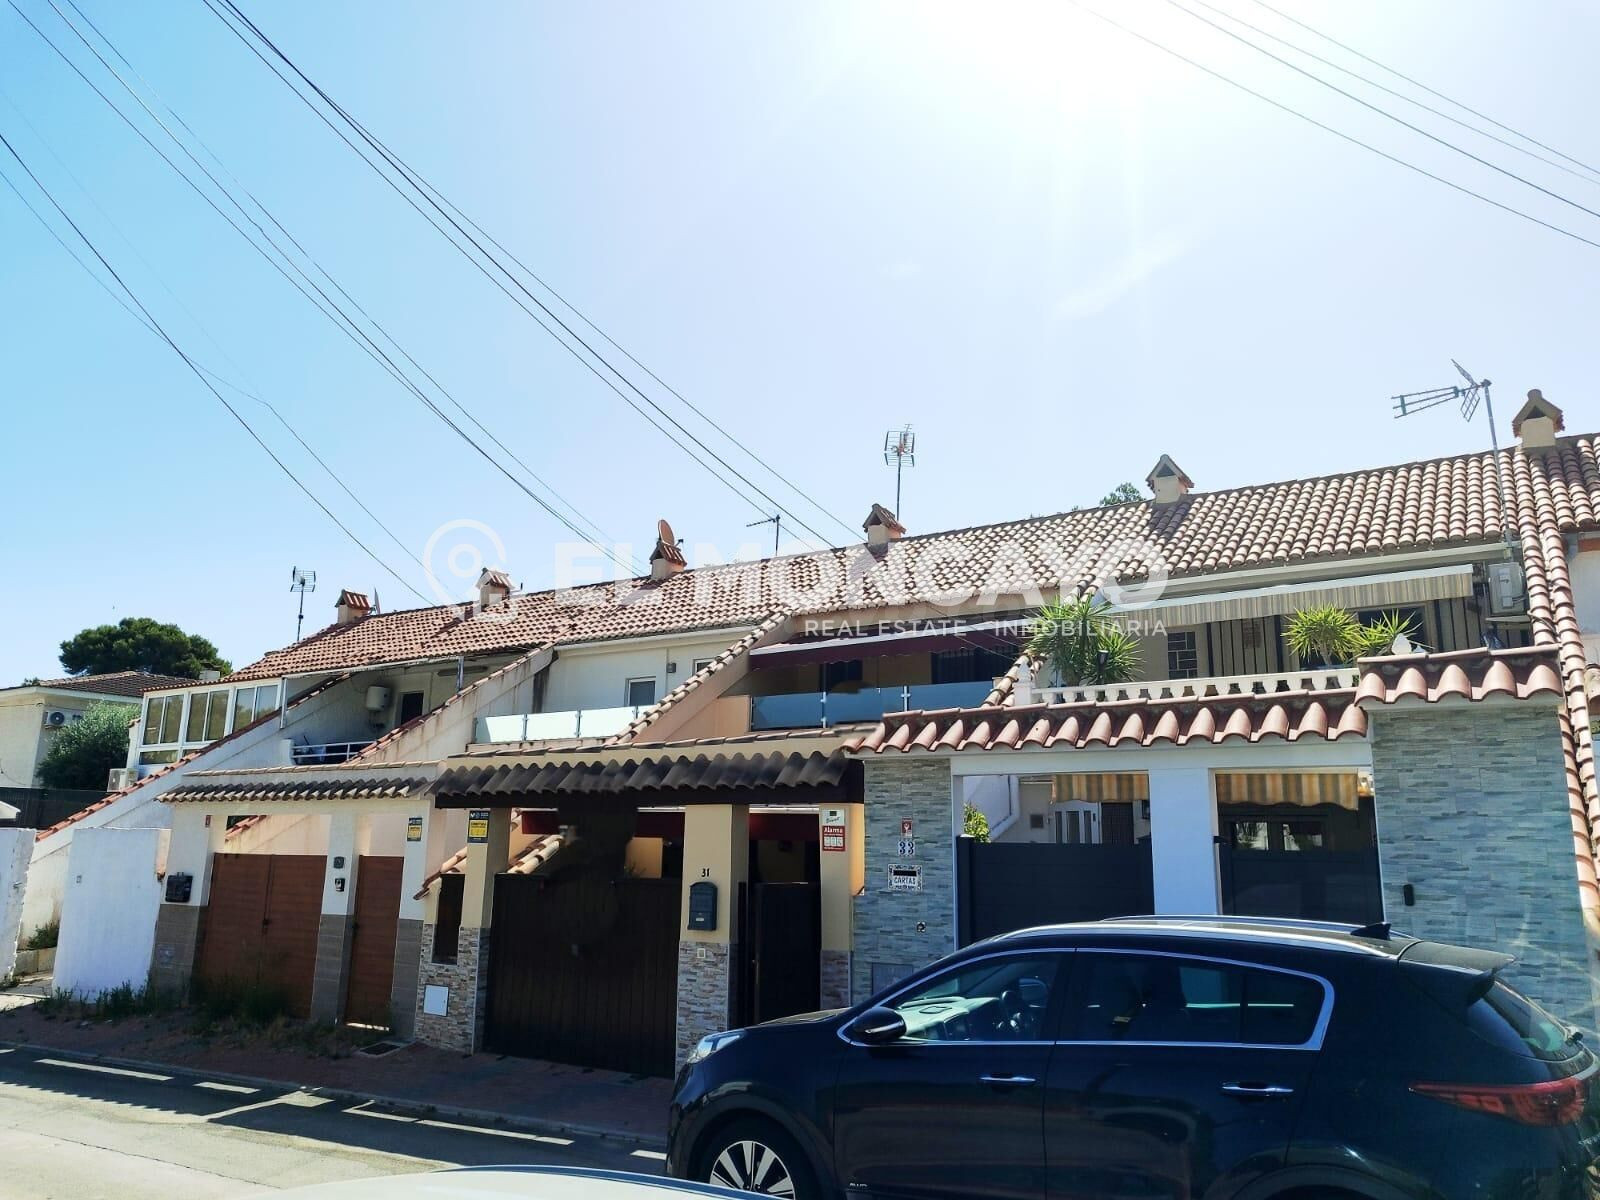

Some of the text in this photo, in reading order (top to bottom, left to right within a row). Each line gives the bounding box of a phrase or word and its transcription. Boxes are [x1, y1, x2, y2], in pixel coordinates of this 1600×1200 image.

[899, 841, 914, 855] 33
[701, 867, 710, 878] 31
[893, 876, 916, 886] CARTAS
